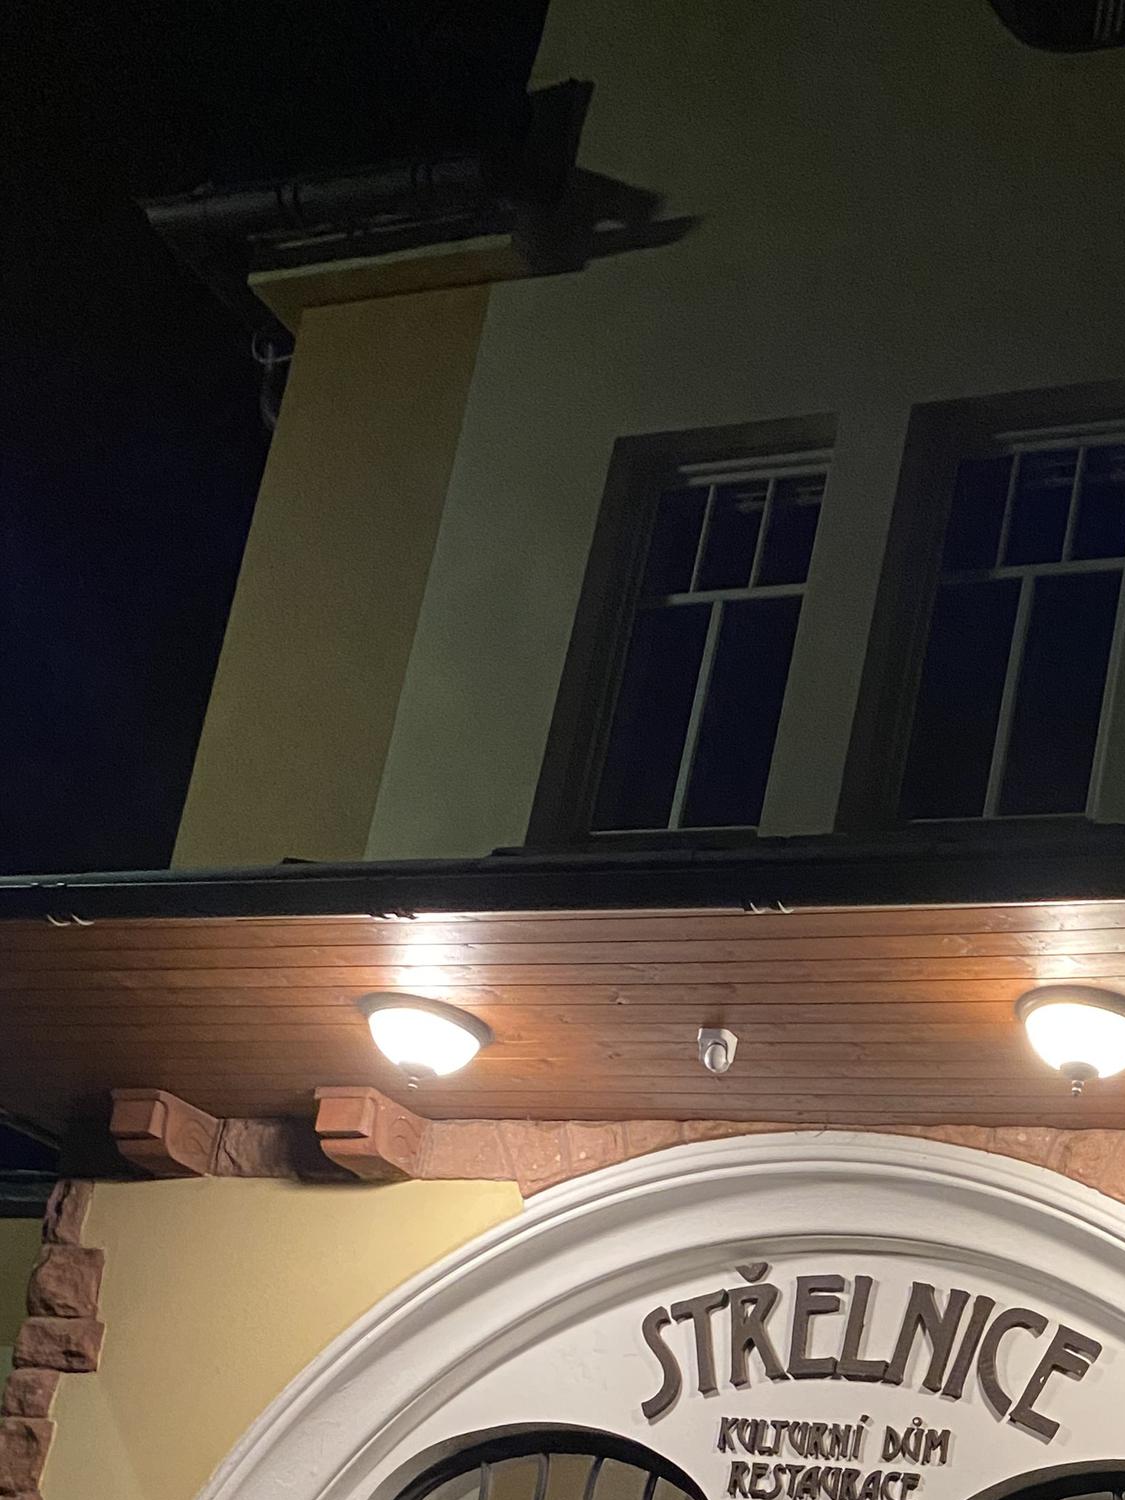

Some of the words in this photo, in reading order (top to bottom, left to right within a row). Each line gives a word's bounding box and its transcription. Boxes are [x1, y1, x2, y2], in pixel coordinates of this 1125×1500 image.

[641, 1262, 1102, 1444] STŘELNICE
[717, 1415, 872, 1460] KULTURNÍ
[883, 1417, 953, 1466] DŮM
